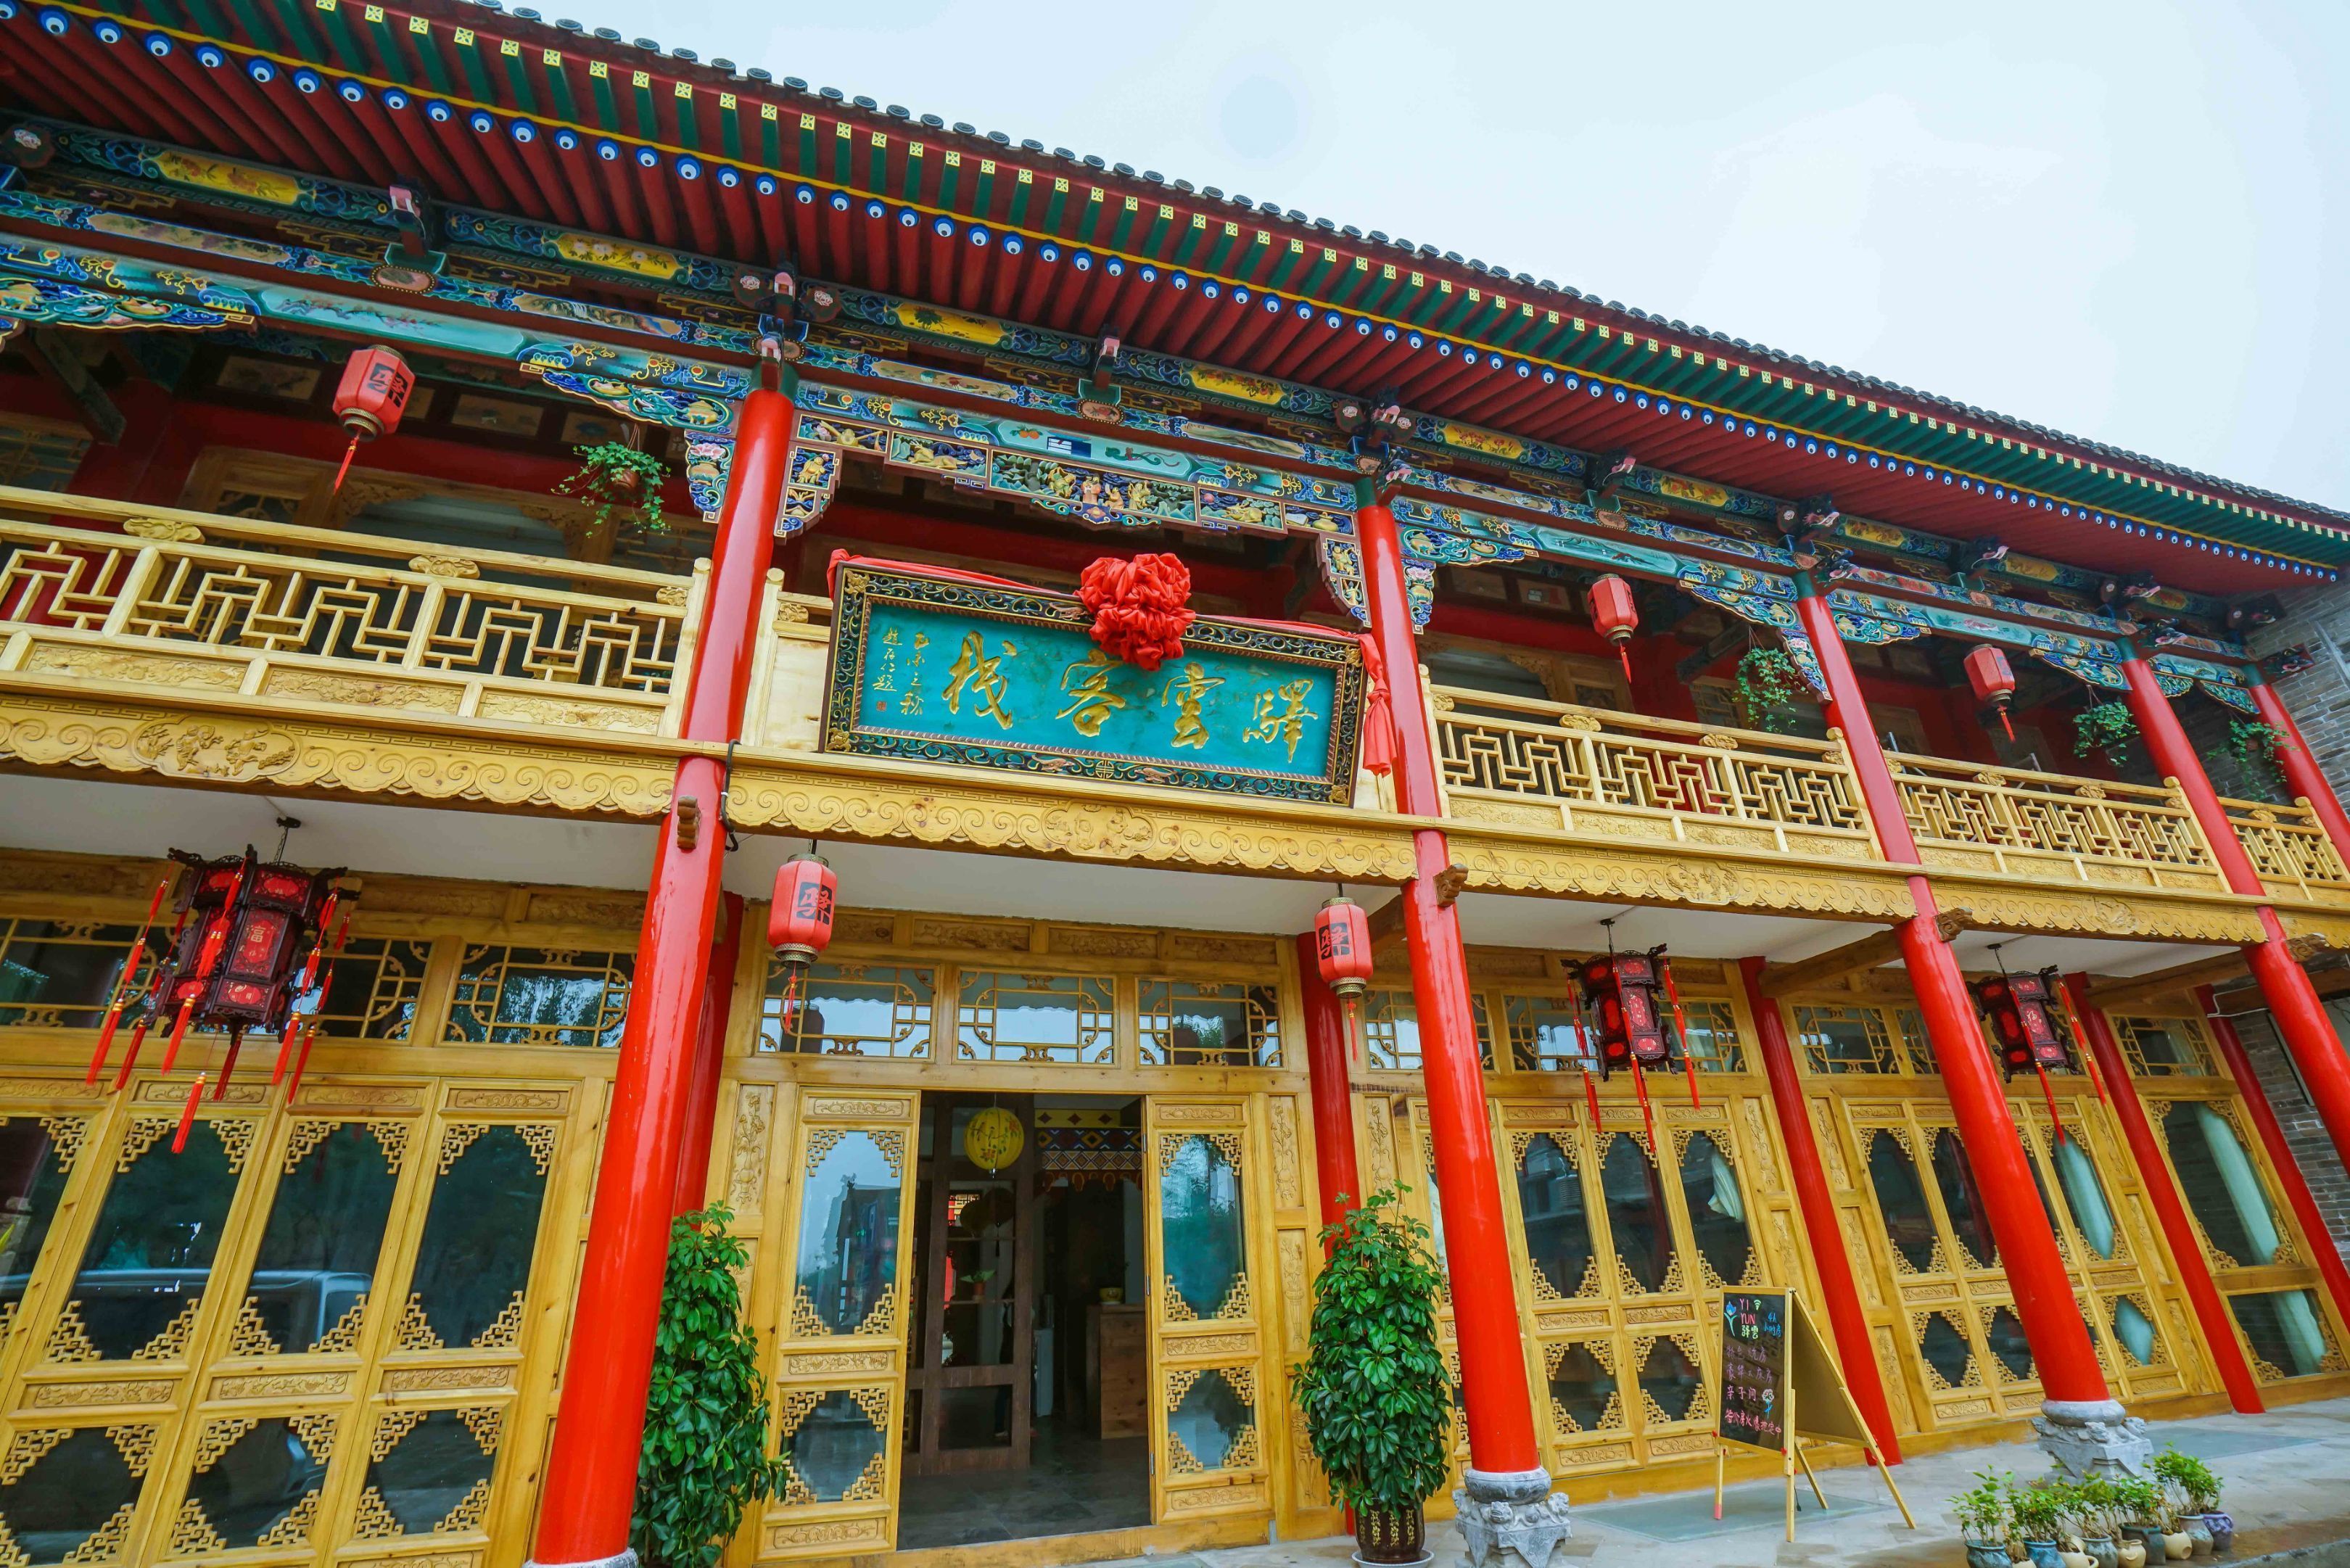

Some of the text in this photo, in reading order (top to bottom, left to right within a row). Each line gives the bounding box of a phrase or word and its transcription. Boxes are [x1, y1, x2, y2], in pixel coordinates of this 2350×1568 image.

[1740, 1313, 1755, 1324] YUN
[1726, 1385, 1757, 1401] 亲子间
